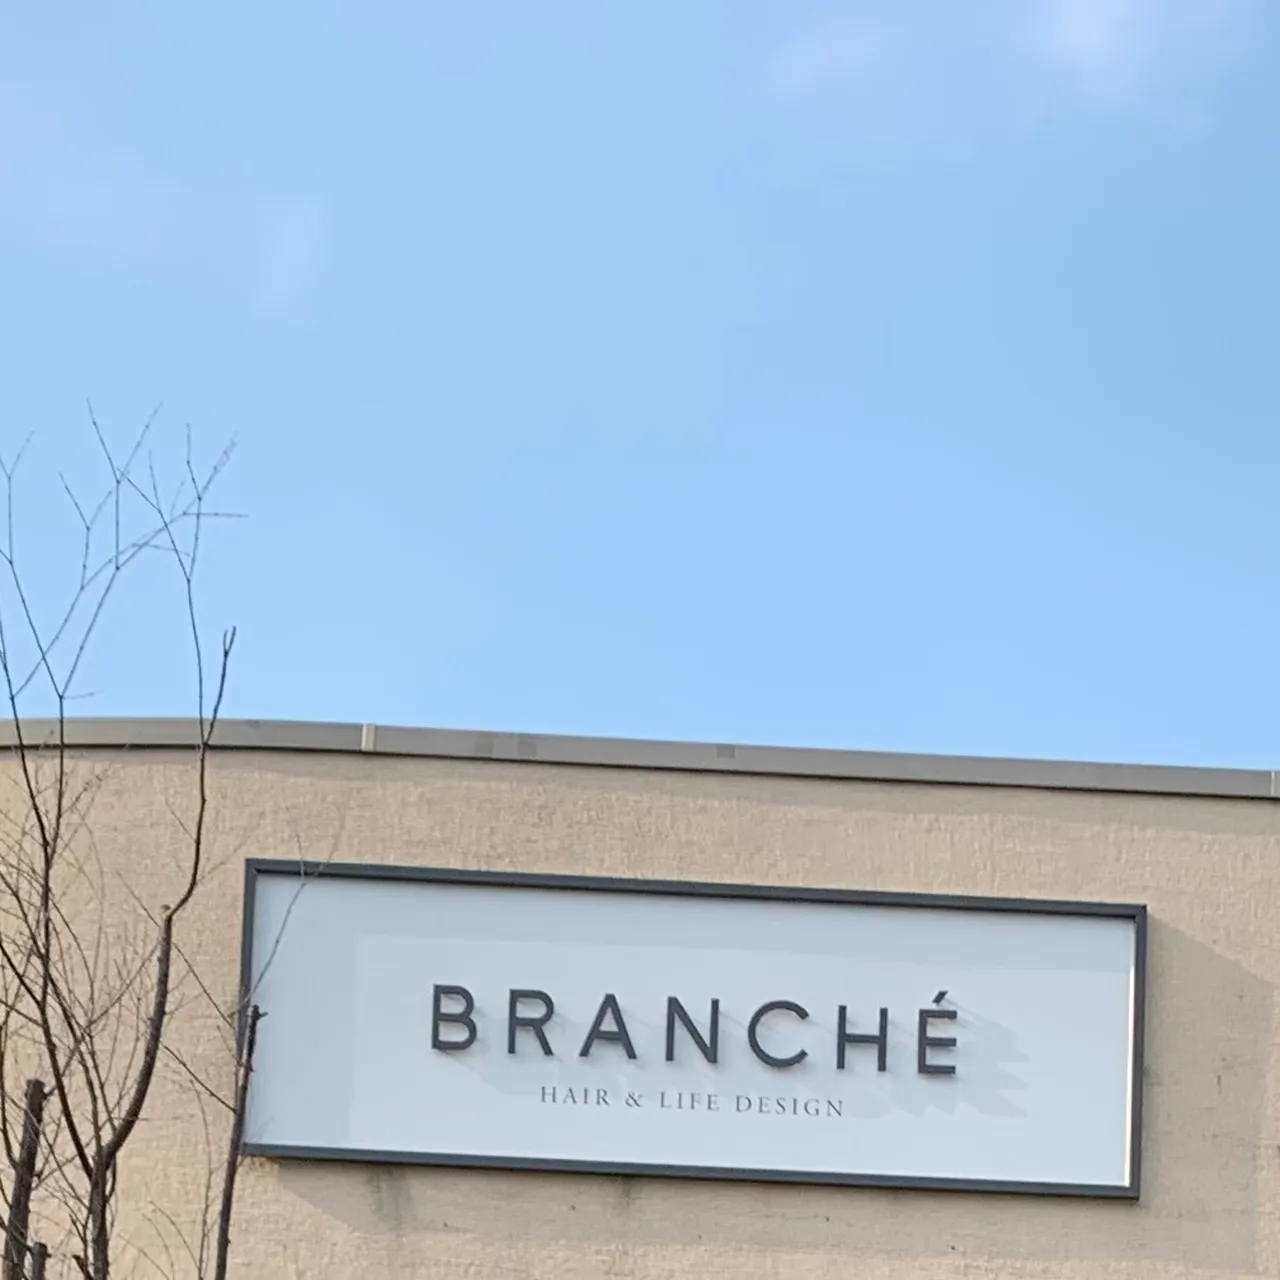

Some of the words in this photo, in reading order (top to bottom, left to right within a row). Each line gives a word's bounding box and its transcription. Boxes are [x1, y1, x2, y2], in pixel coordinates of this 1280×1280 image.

[430, 983, 959, 1078] BRANCHÉ
[539, 1085, 611, 1108] HAIR
[624, 1091, 644, 1109] &
[659, 1091, 720, 1112] LIFE
[734, 1094, 845, 1118] DESIGN
